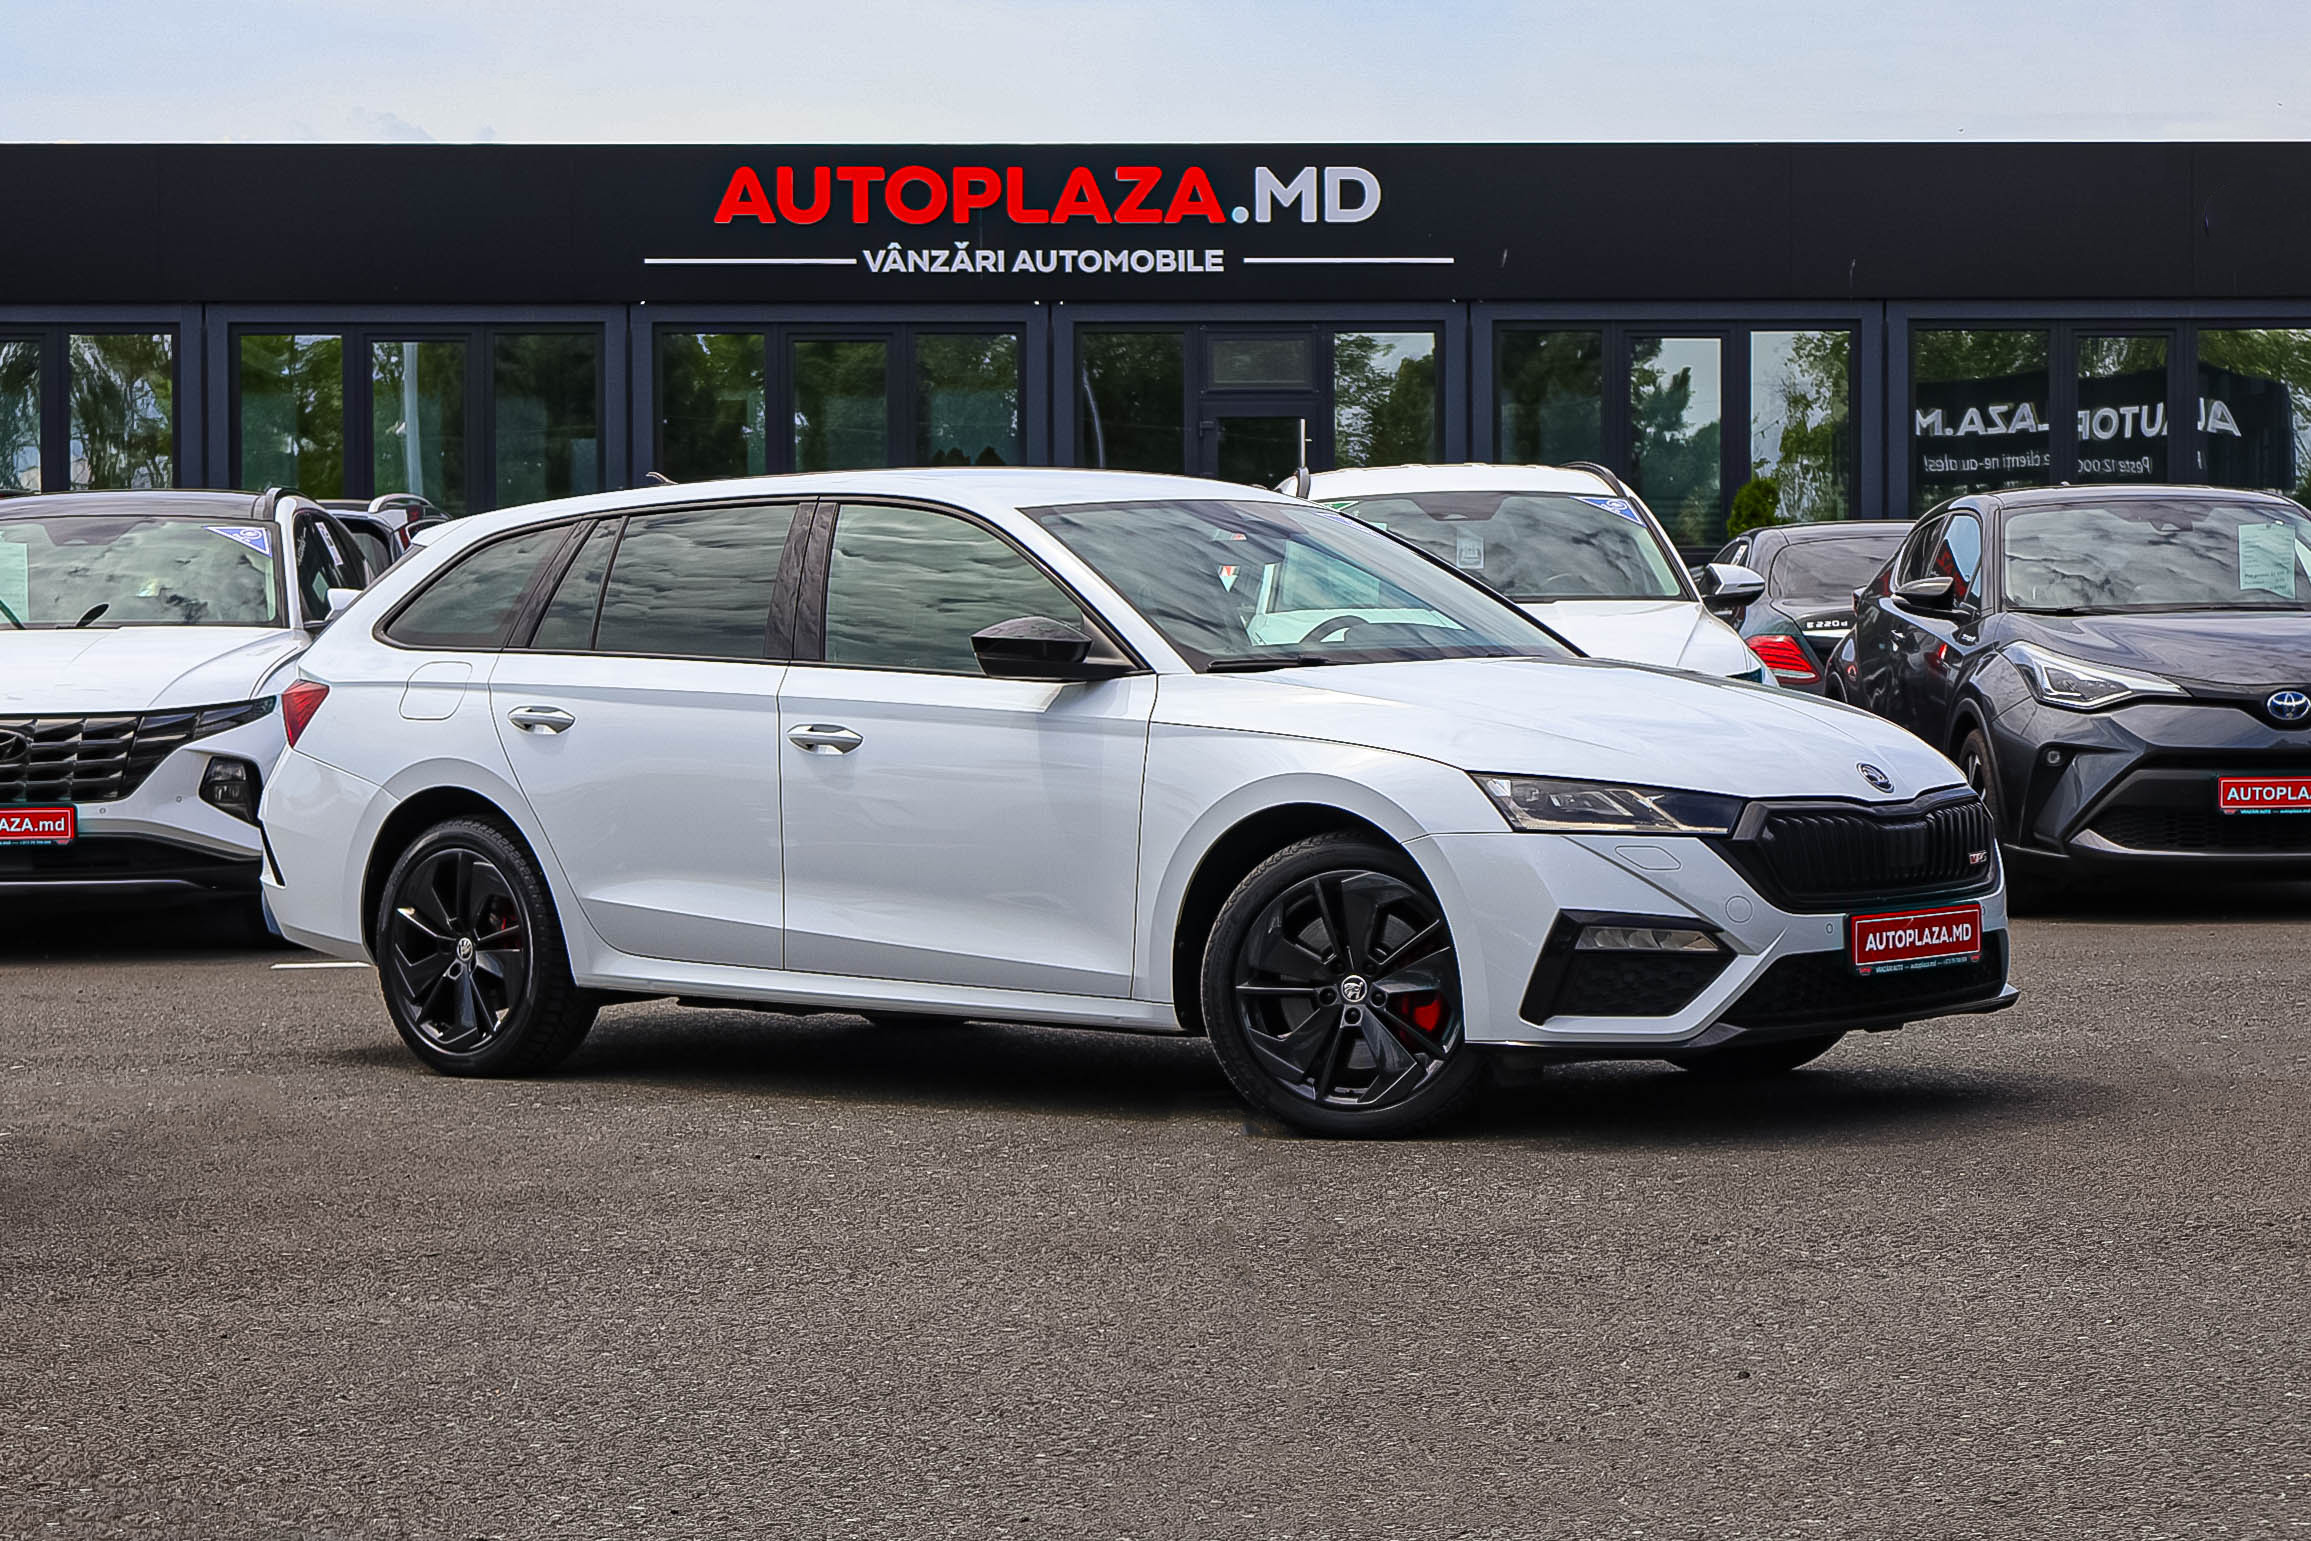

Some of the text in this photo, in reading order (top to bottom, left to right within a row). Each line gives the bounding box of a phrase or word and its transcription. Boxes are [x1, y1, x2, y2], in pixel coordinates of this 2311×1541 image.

[713, 165, 1382, 225] AUTOPLAZA.MD
[862, 240, 1225, 274] VÂNZĂRI AUTOMOBILE
[2226, 785, 2311, 801] AUTOPLA
[1864, 922, 1973, 952] AUTOPLAZA.MD
